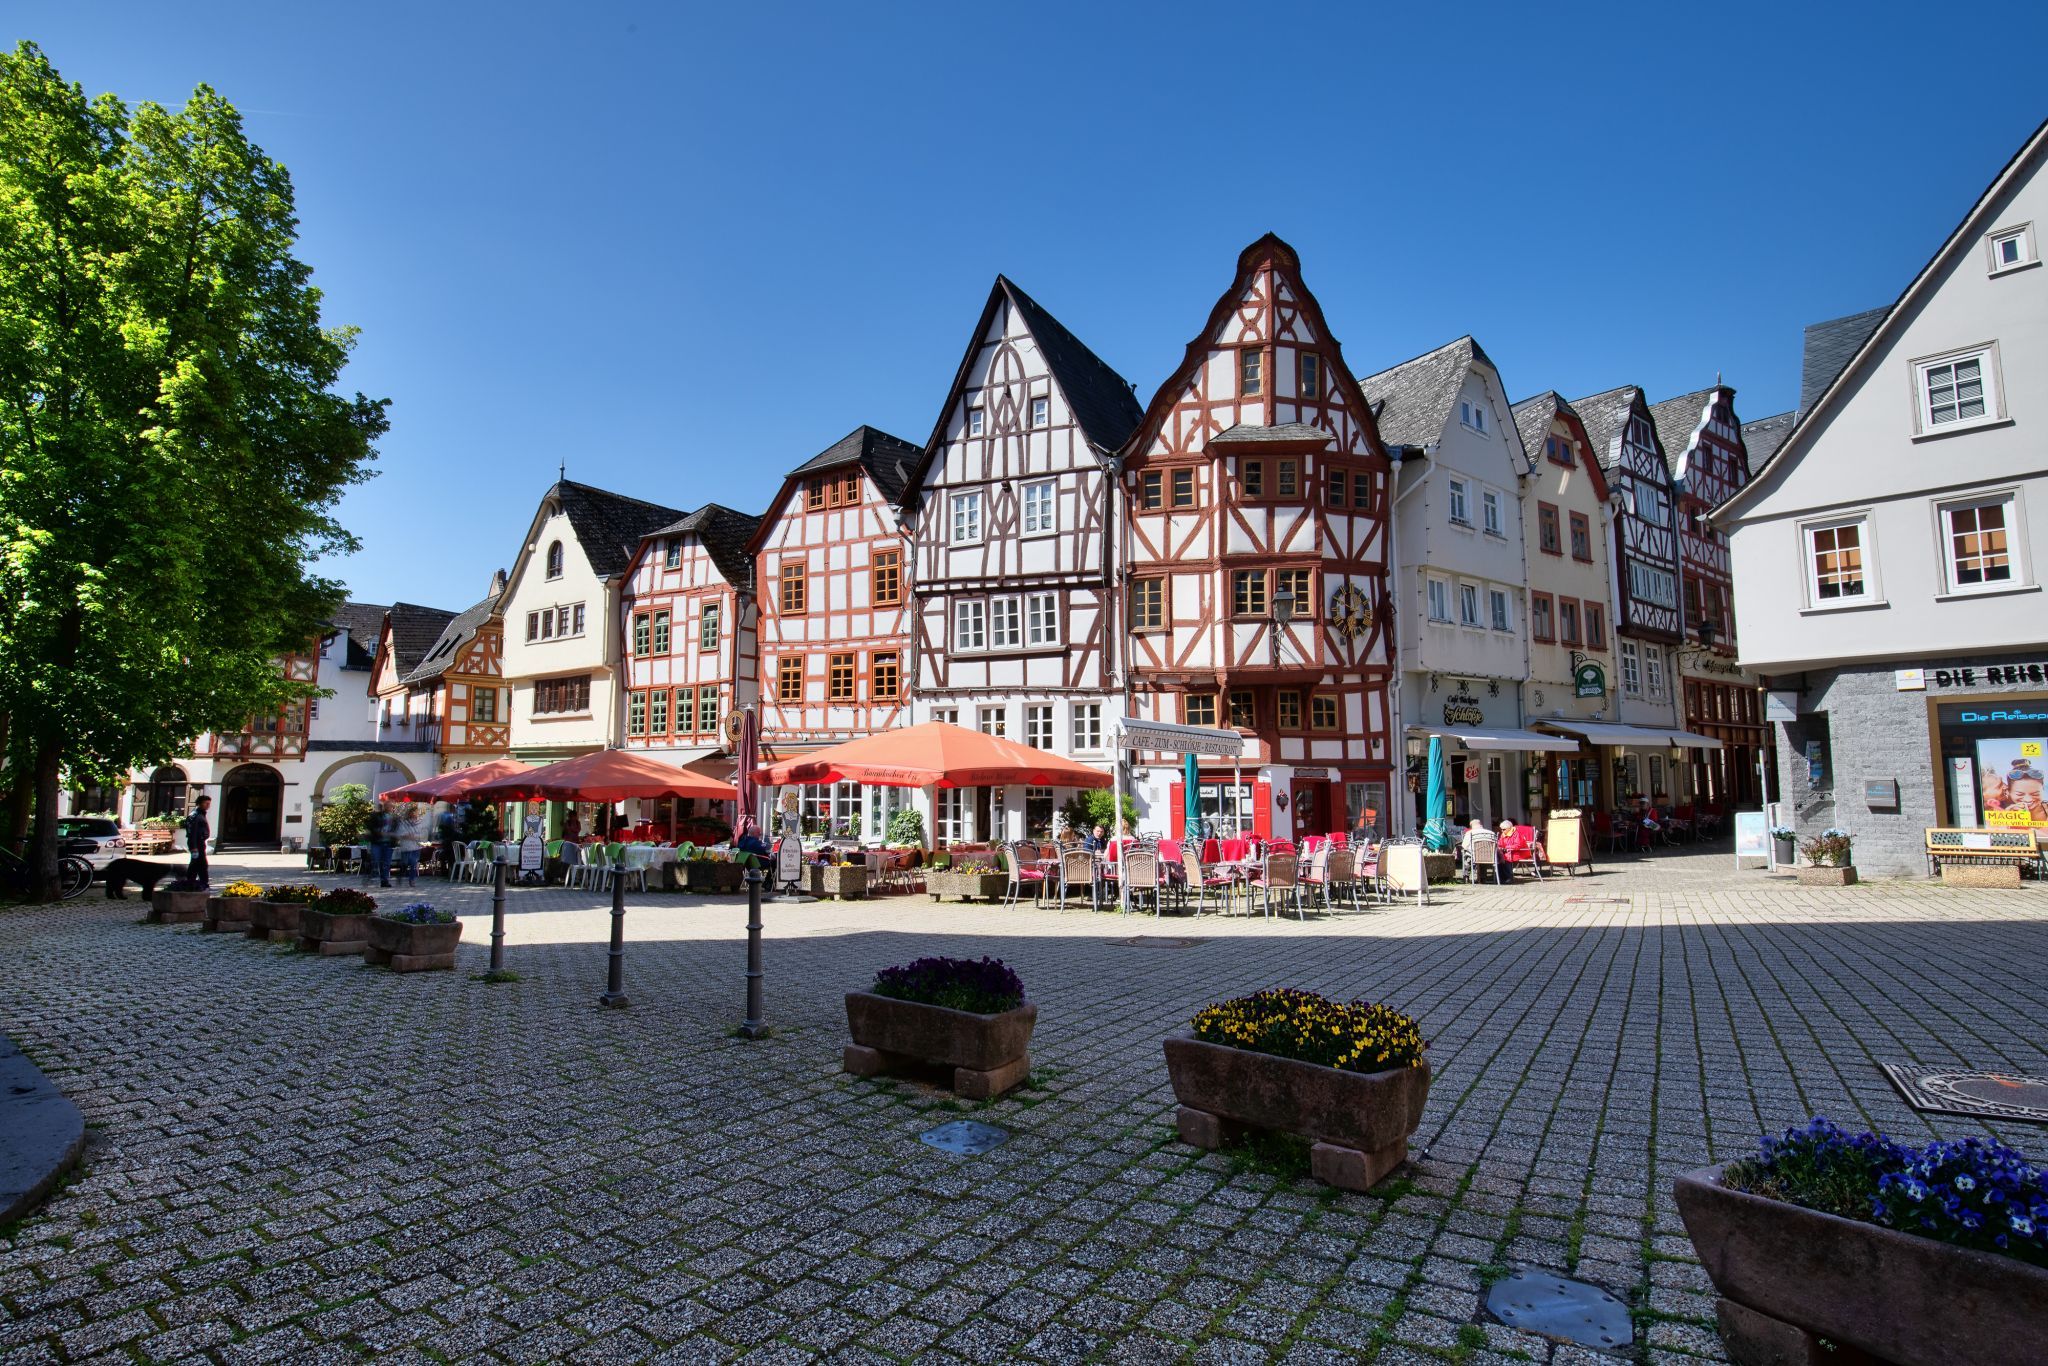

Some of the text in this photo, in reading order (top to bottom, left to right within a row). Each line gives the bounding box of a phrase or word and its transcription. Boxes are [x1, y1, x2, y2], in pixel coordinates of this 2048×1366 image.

[1936, 669, 1976, 688] DIE
[1961, 712, 1989, 722] Die
[1465, 764, 1480, 780] Eis
[1988, 812, 2028, 820] MAGIC.
